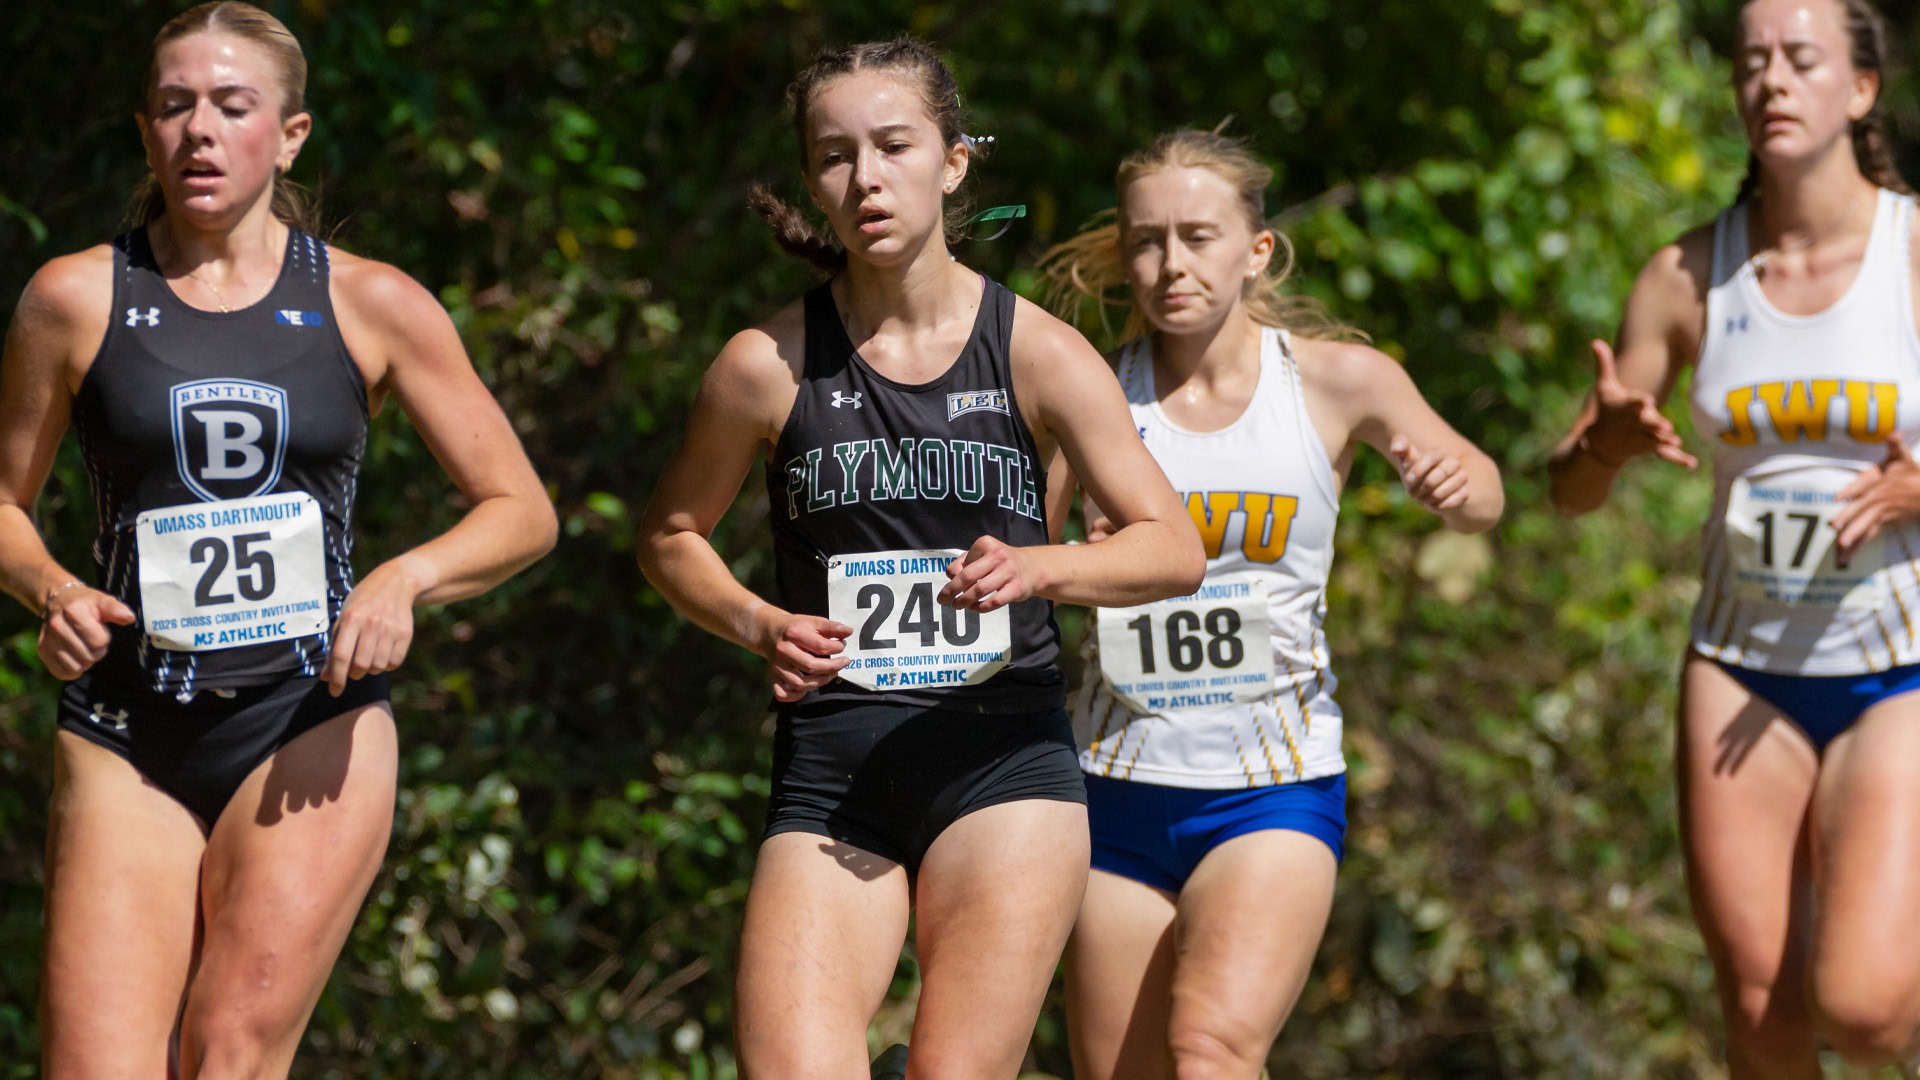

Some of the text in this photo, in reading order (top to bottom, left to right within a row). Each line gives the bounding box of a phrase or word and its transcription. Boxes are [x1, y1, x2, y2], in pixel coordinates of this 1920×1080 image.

[180, 386, 277, 404] BENTLEY
[950, 390, 1007, 414] LEC
[1719, 379, 1899, 446] JWU
[191, 410, 265, 480] B
[784, 437, 1043, 522] PLYMOUTH
[153, 502, 301, 535] UMASS DARTMOUTH
[1177, 490, 1299, 565] WU
[189, 531, 276, 608] 25
[845, 556, 958, 577] UMASS DARTM
[1165, 583, 1250, 603] MOUTH
[152, 600, 321, 632] 2026 CROSS COUNTRY INVITATIONAL
[856, 581, 981, 651] 240
[218, 621, 286, 644] ATHLETIC
[1128, 607, 1245, 675] 168
[843, 651, 1005, 670] 26 CROSS COUNTRY INVITATIONAL
[899, 669, 968, 686] ATHLETIC
[1170, 691, 1234, 708] ATHLETIC
